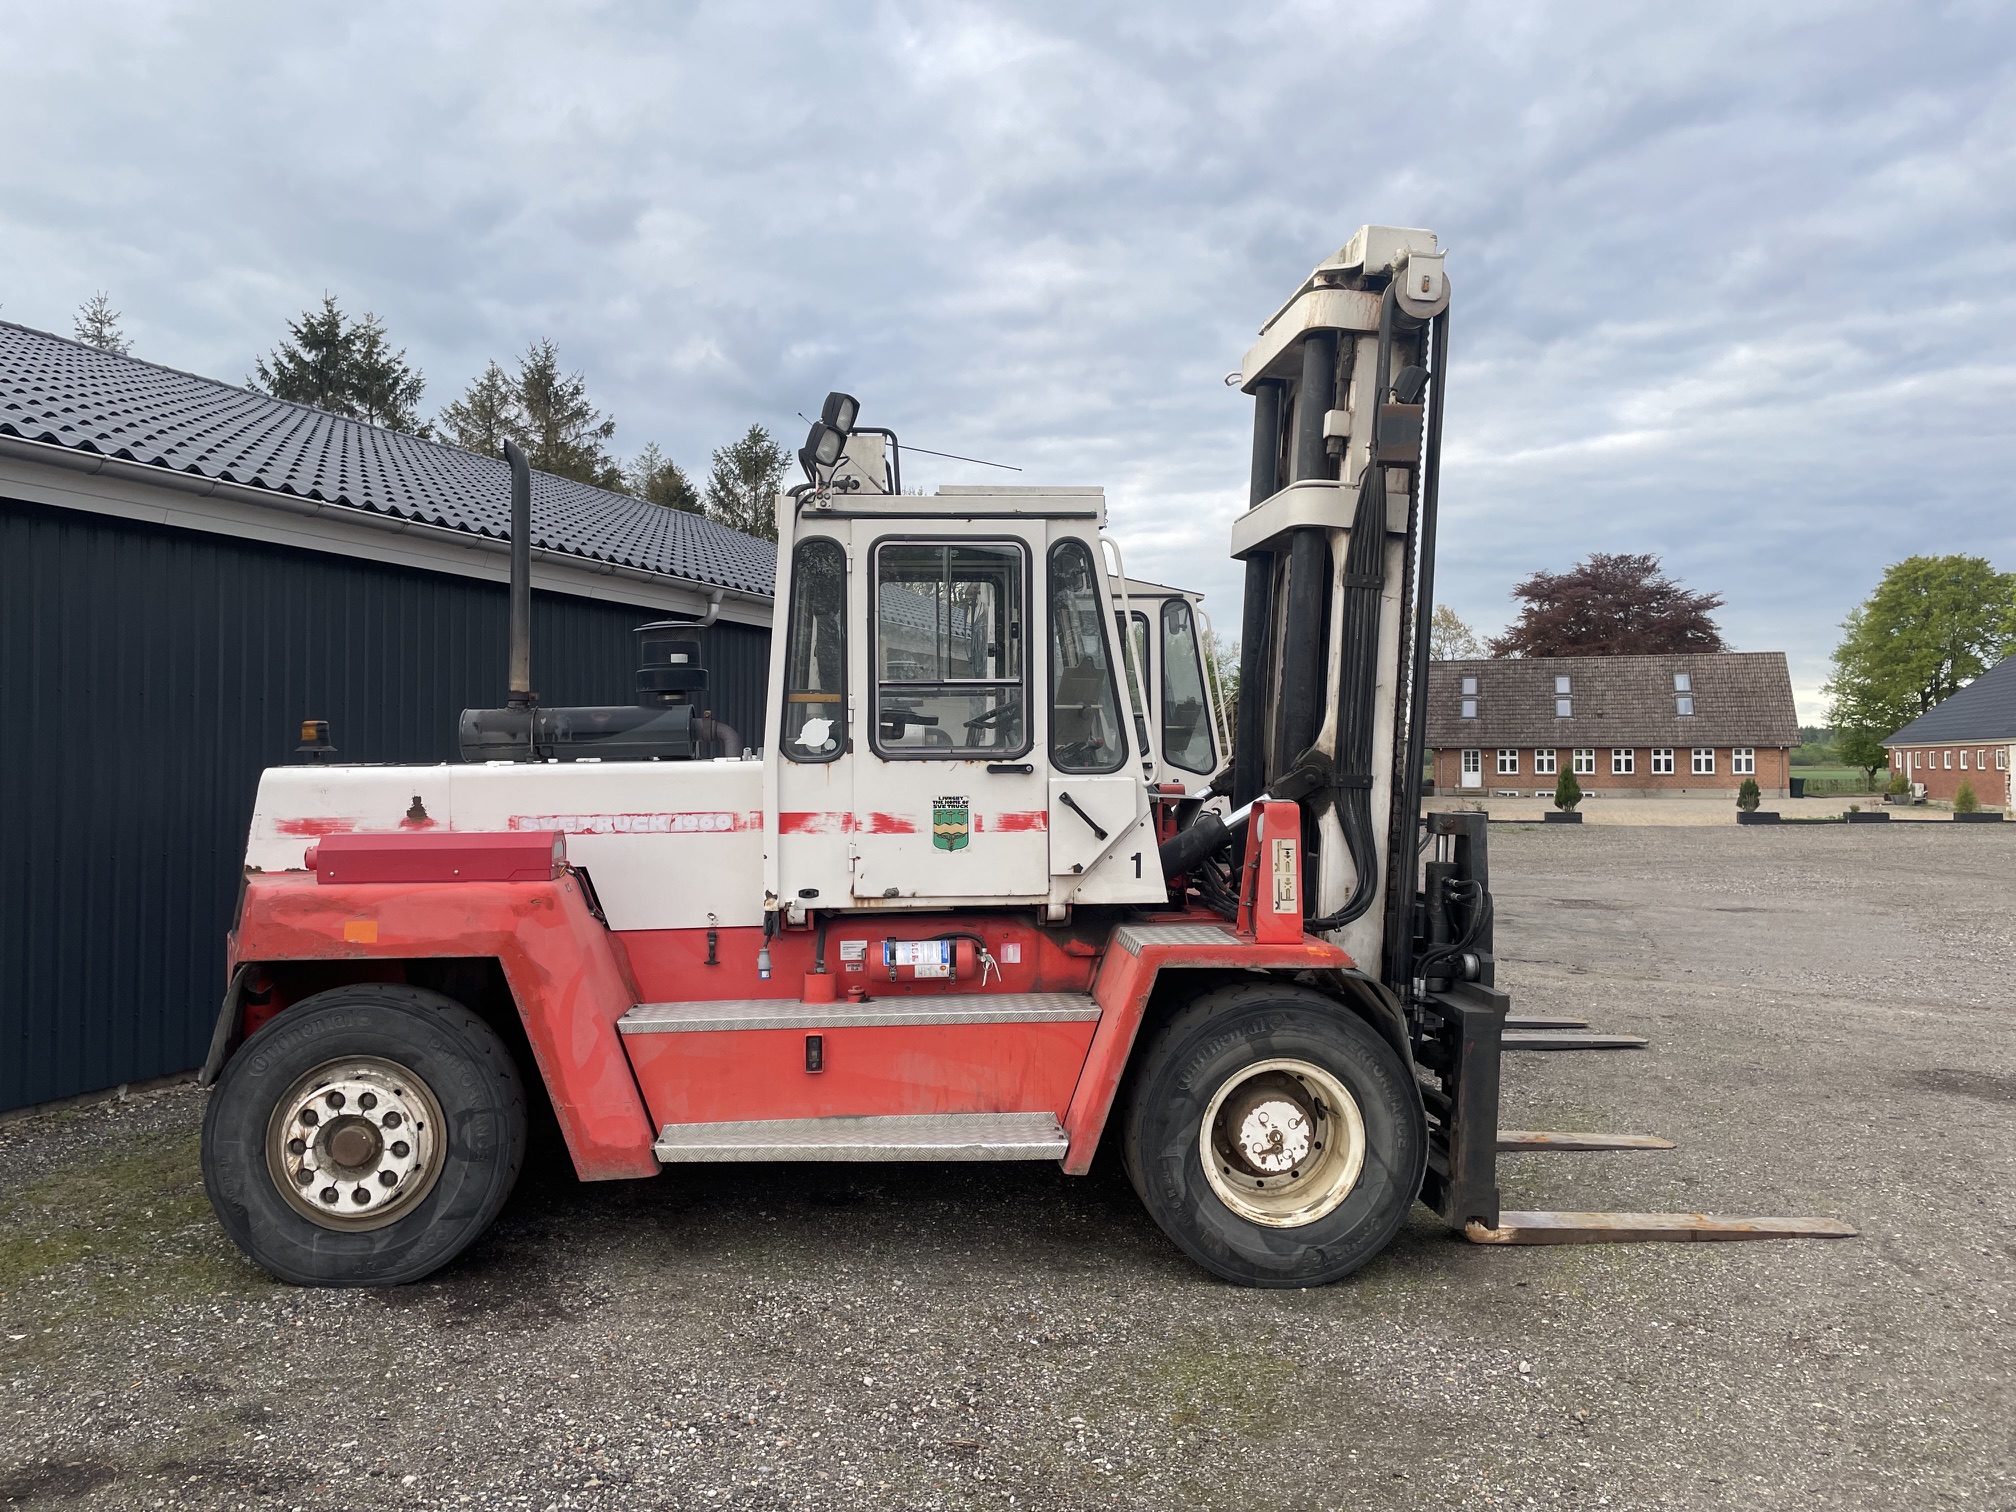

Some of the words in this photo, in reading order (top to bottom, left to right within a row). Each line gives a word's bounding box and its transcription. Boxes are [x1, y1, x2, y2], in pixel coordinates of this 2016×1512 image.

[520, 816, 668, 832] SVETRUCK
[673, 814, 732, 832] 1960
[1130, 852, 1142, 878] 1
[247, 1008, 355, 1077] Continental
[1177, 1015, 1268, 1091] Continental
[425, 1034, 490, 1161] PERFORMANCE
